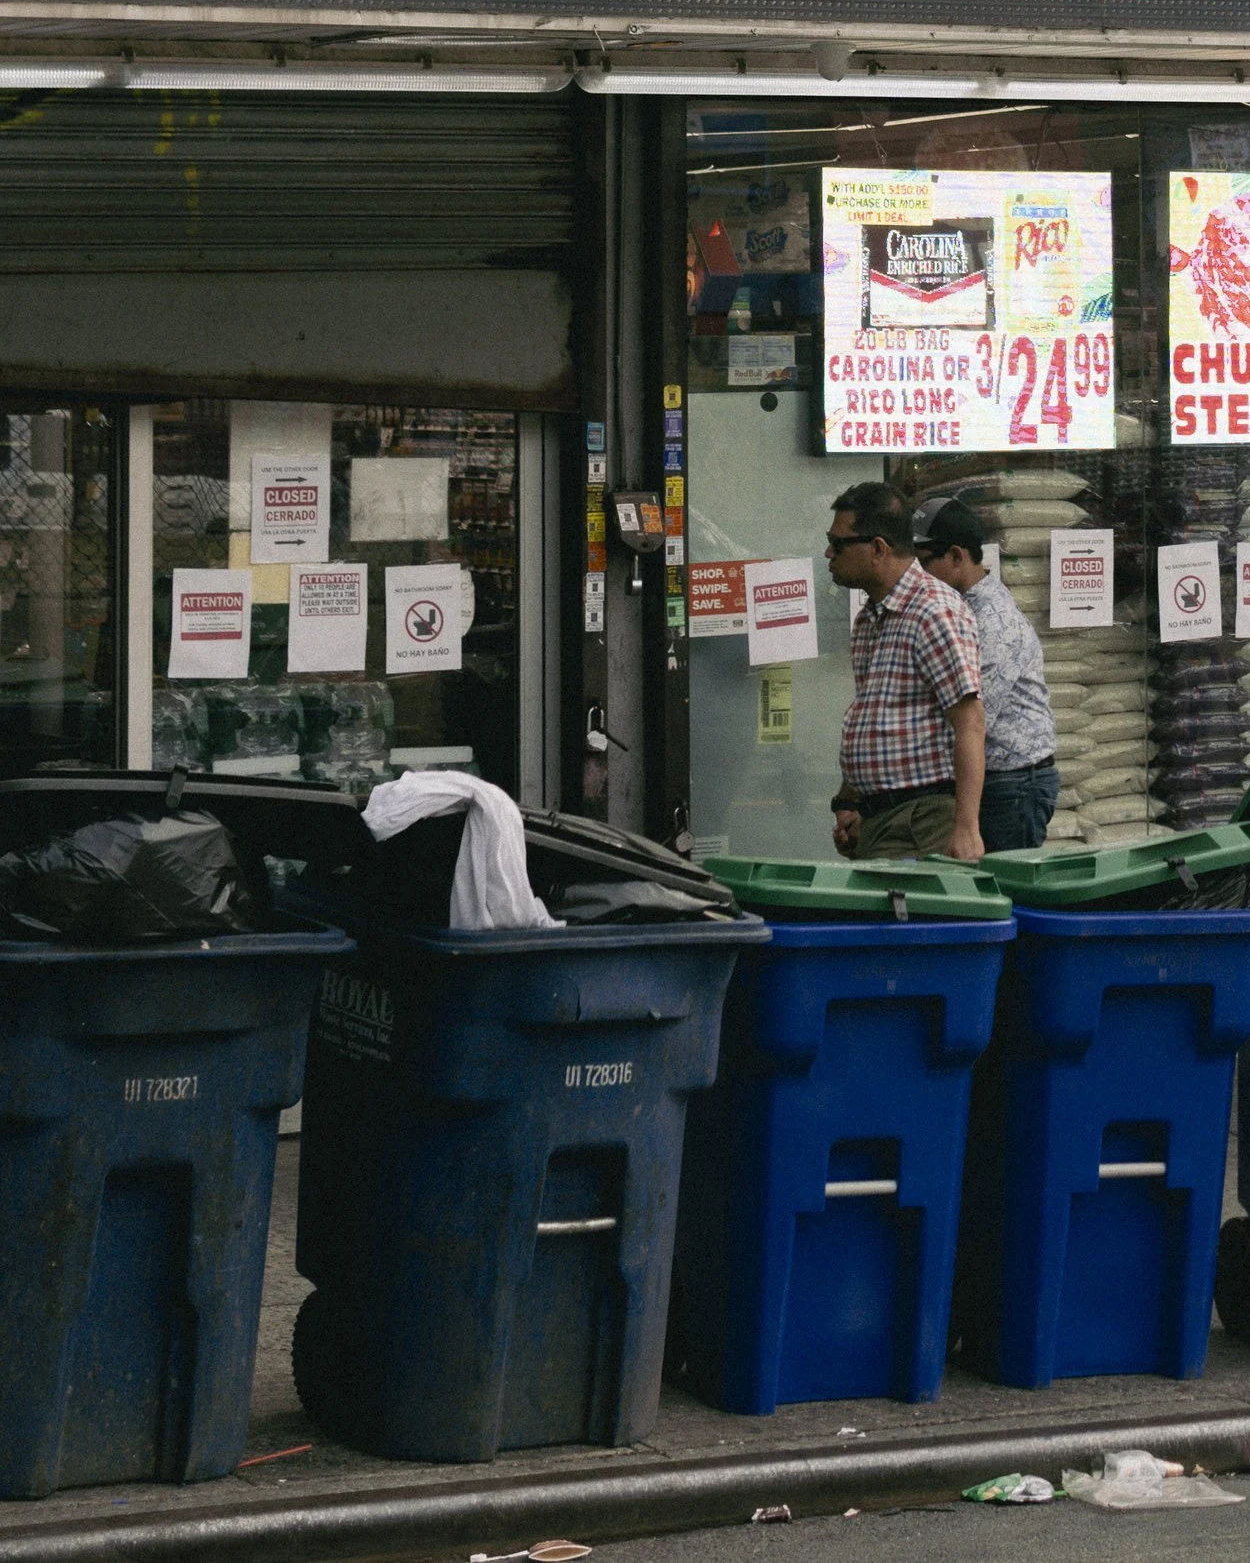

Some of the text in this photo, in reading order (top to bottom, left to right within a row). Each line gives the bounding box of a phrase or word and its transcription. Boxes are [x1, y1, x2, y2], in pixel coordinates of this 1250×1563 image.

[834, 196, 881, 209] URCHASE
[886, 230, 968, 261] CAROLINA
[829, 355, 970, 383] CAROLINA OR
[846, 387, 956, 415] RICO LONG
[841, 421, 960, 447] GRAIN RICE
[265, 488, 317, 504] CLOSED
[266, 509, 316, 522] CERRADO
[1062, 560, 1103, 573] CLOSED
[301, 574, 360, 584] ATTENTION
[691, 568, 726, 580] SHOP.
[692, 583, 732, 595] SWIPE.
[1062, 579, 1103, 590] CERRADO
[755, 583, 807, 600] ATTENTION
[182, 596, 242, 608] ATTENTION
[692, 599, 724, 610] SAVE.
[396, 646, 450, 659] NO HAY BAÑO
[319, 969, 396, 1024] ROYAL
[584, 1061, 633, 1087] 728316
